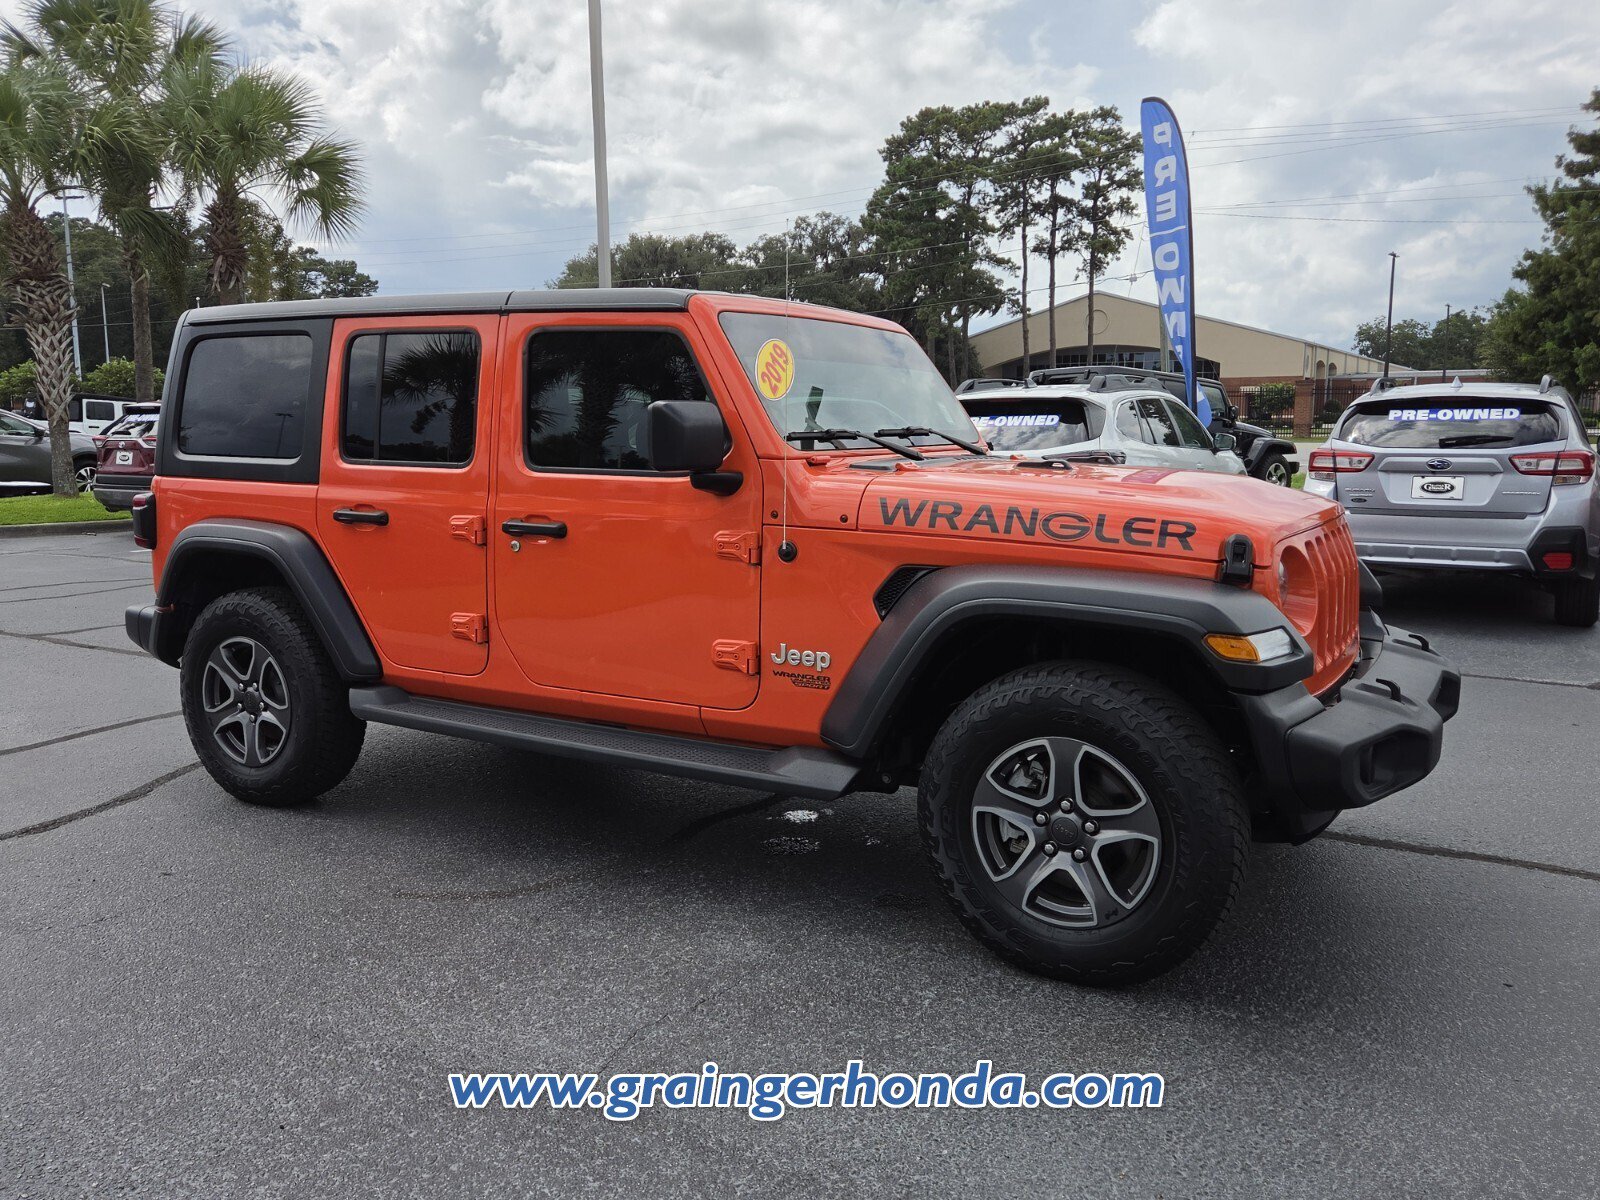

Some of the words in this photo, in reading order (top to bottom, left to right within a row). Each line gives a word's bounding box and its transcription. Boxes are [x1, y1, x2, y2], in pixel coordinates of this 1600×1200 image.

[761, 343, 789, 396] 2019
[1388, 408, 1521, 421] PRE-OWNED
[878, 497, 1197, 551] WRANGLER
[771, 643, 831, 671] Jeep
[773, 670, 831, 682] WRANGLER
